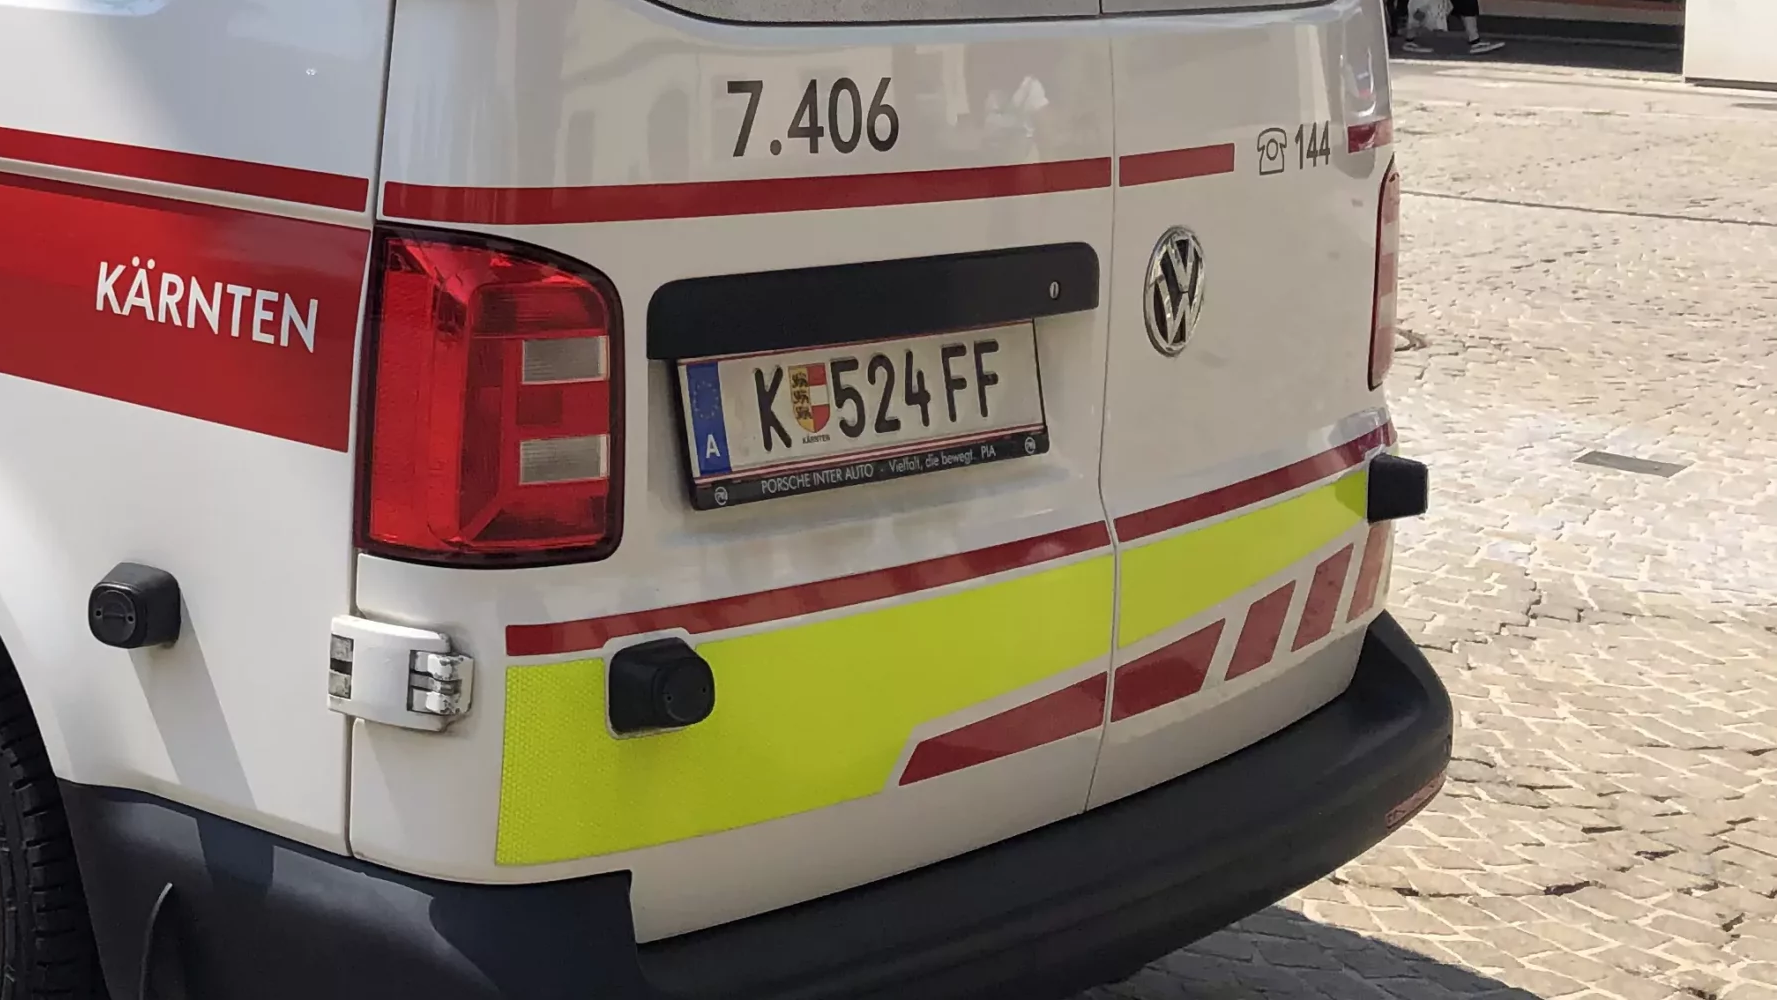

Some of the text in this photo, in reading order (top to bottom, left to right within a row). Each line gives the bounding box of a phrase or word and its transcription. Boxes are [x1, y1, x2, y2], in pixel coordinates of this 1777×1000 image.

[727, 77, 899, 157] 7.406
[1294, 120, 1331, 170] 144
[96, 256, 318, 353] KÄRNTEN
[753, 365, 792, 451] K
[705, 434, 721, 459] A
[761, 474, 811, 494] PORSCHE
[813, 469, 843, 486] INTER
[845, 463, 874, 480] AUTO
[925, 453, 940, 468] die
[980, 445, 997, 460] PIA
